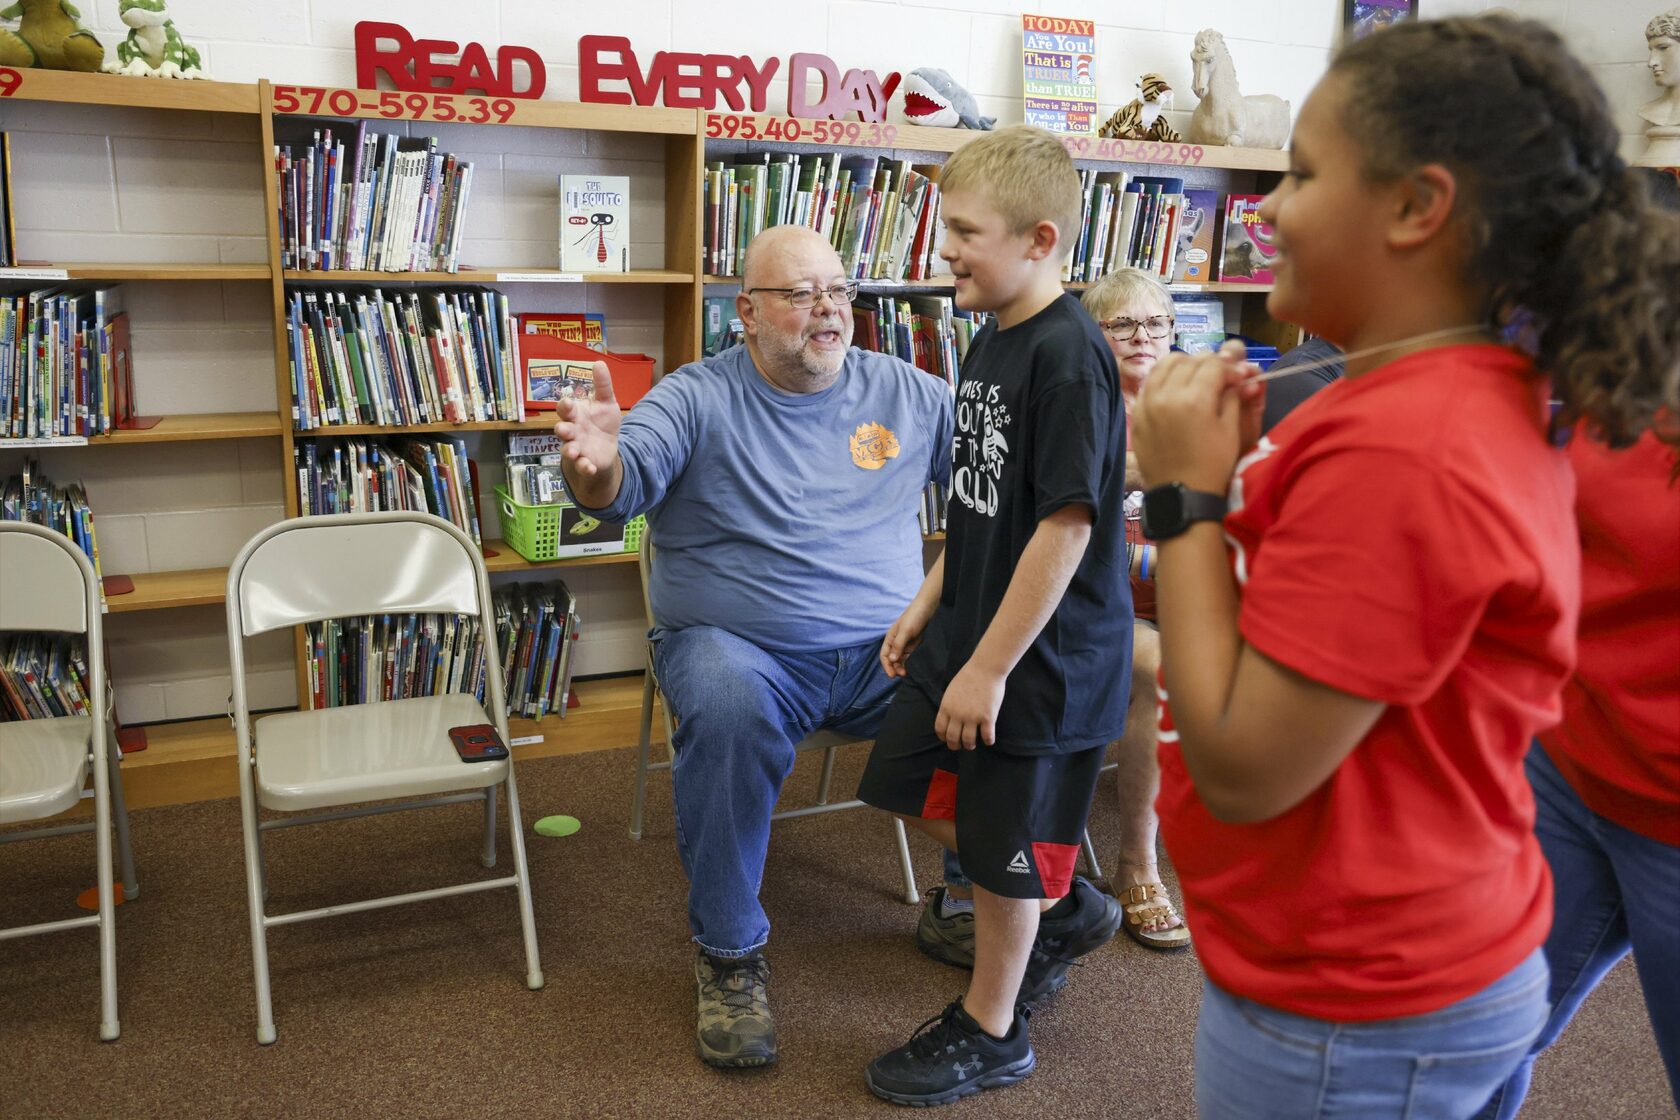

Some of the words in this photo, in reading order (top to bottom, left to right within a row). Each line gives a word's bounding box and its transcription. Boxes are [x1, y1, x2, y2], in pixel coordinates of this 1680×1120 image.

[1024, 16, 1092, 35] TODAY
[1026, 35, 1053, 50] Are
[1054, 35, 1094, 53] You!
[1025, 52, 1058, 67] That
[1060, 56, 1071, 68] is
[354, 20, 547, 100] READ
[578, 34, 781, 113] EVERY
[787, 52, 902, 123] DAY
[1028, 68, 1070, 80] TRUER
[1026, 82, 1052, 94] than
[1055, 86, 1096, 98] TRUE!
[273, 86, 516, 124] 570-595.39
[1026, 100, 1050, 110] There
[1051, 102, 1058, 110] is
[1072, 102, 1095, 112] alive
[1038, 113, 1056, 121] who
[1058, 113, 1065, 121] is
[705, 114, 898, 147] 595.40-599.39
[586, 181, 601, 191] THE
[558, 326, 582, 342] WIN?
[586, 326, 600, 340] IN?
[986, 384, 1001, 404] IS
[1006, 865, 1031, 874] Reebok
